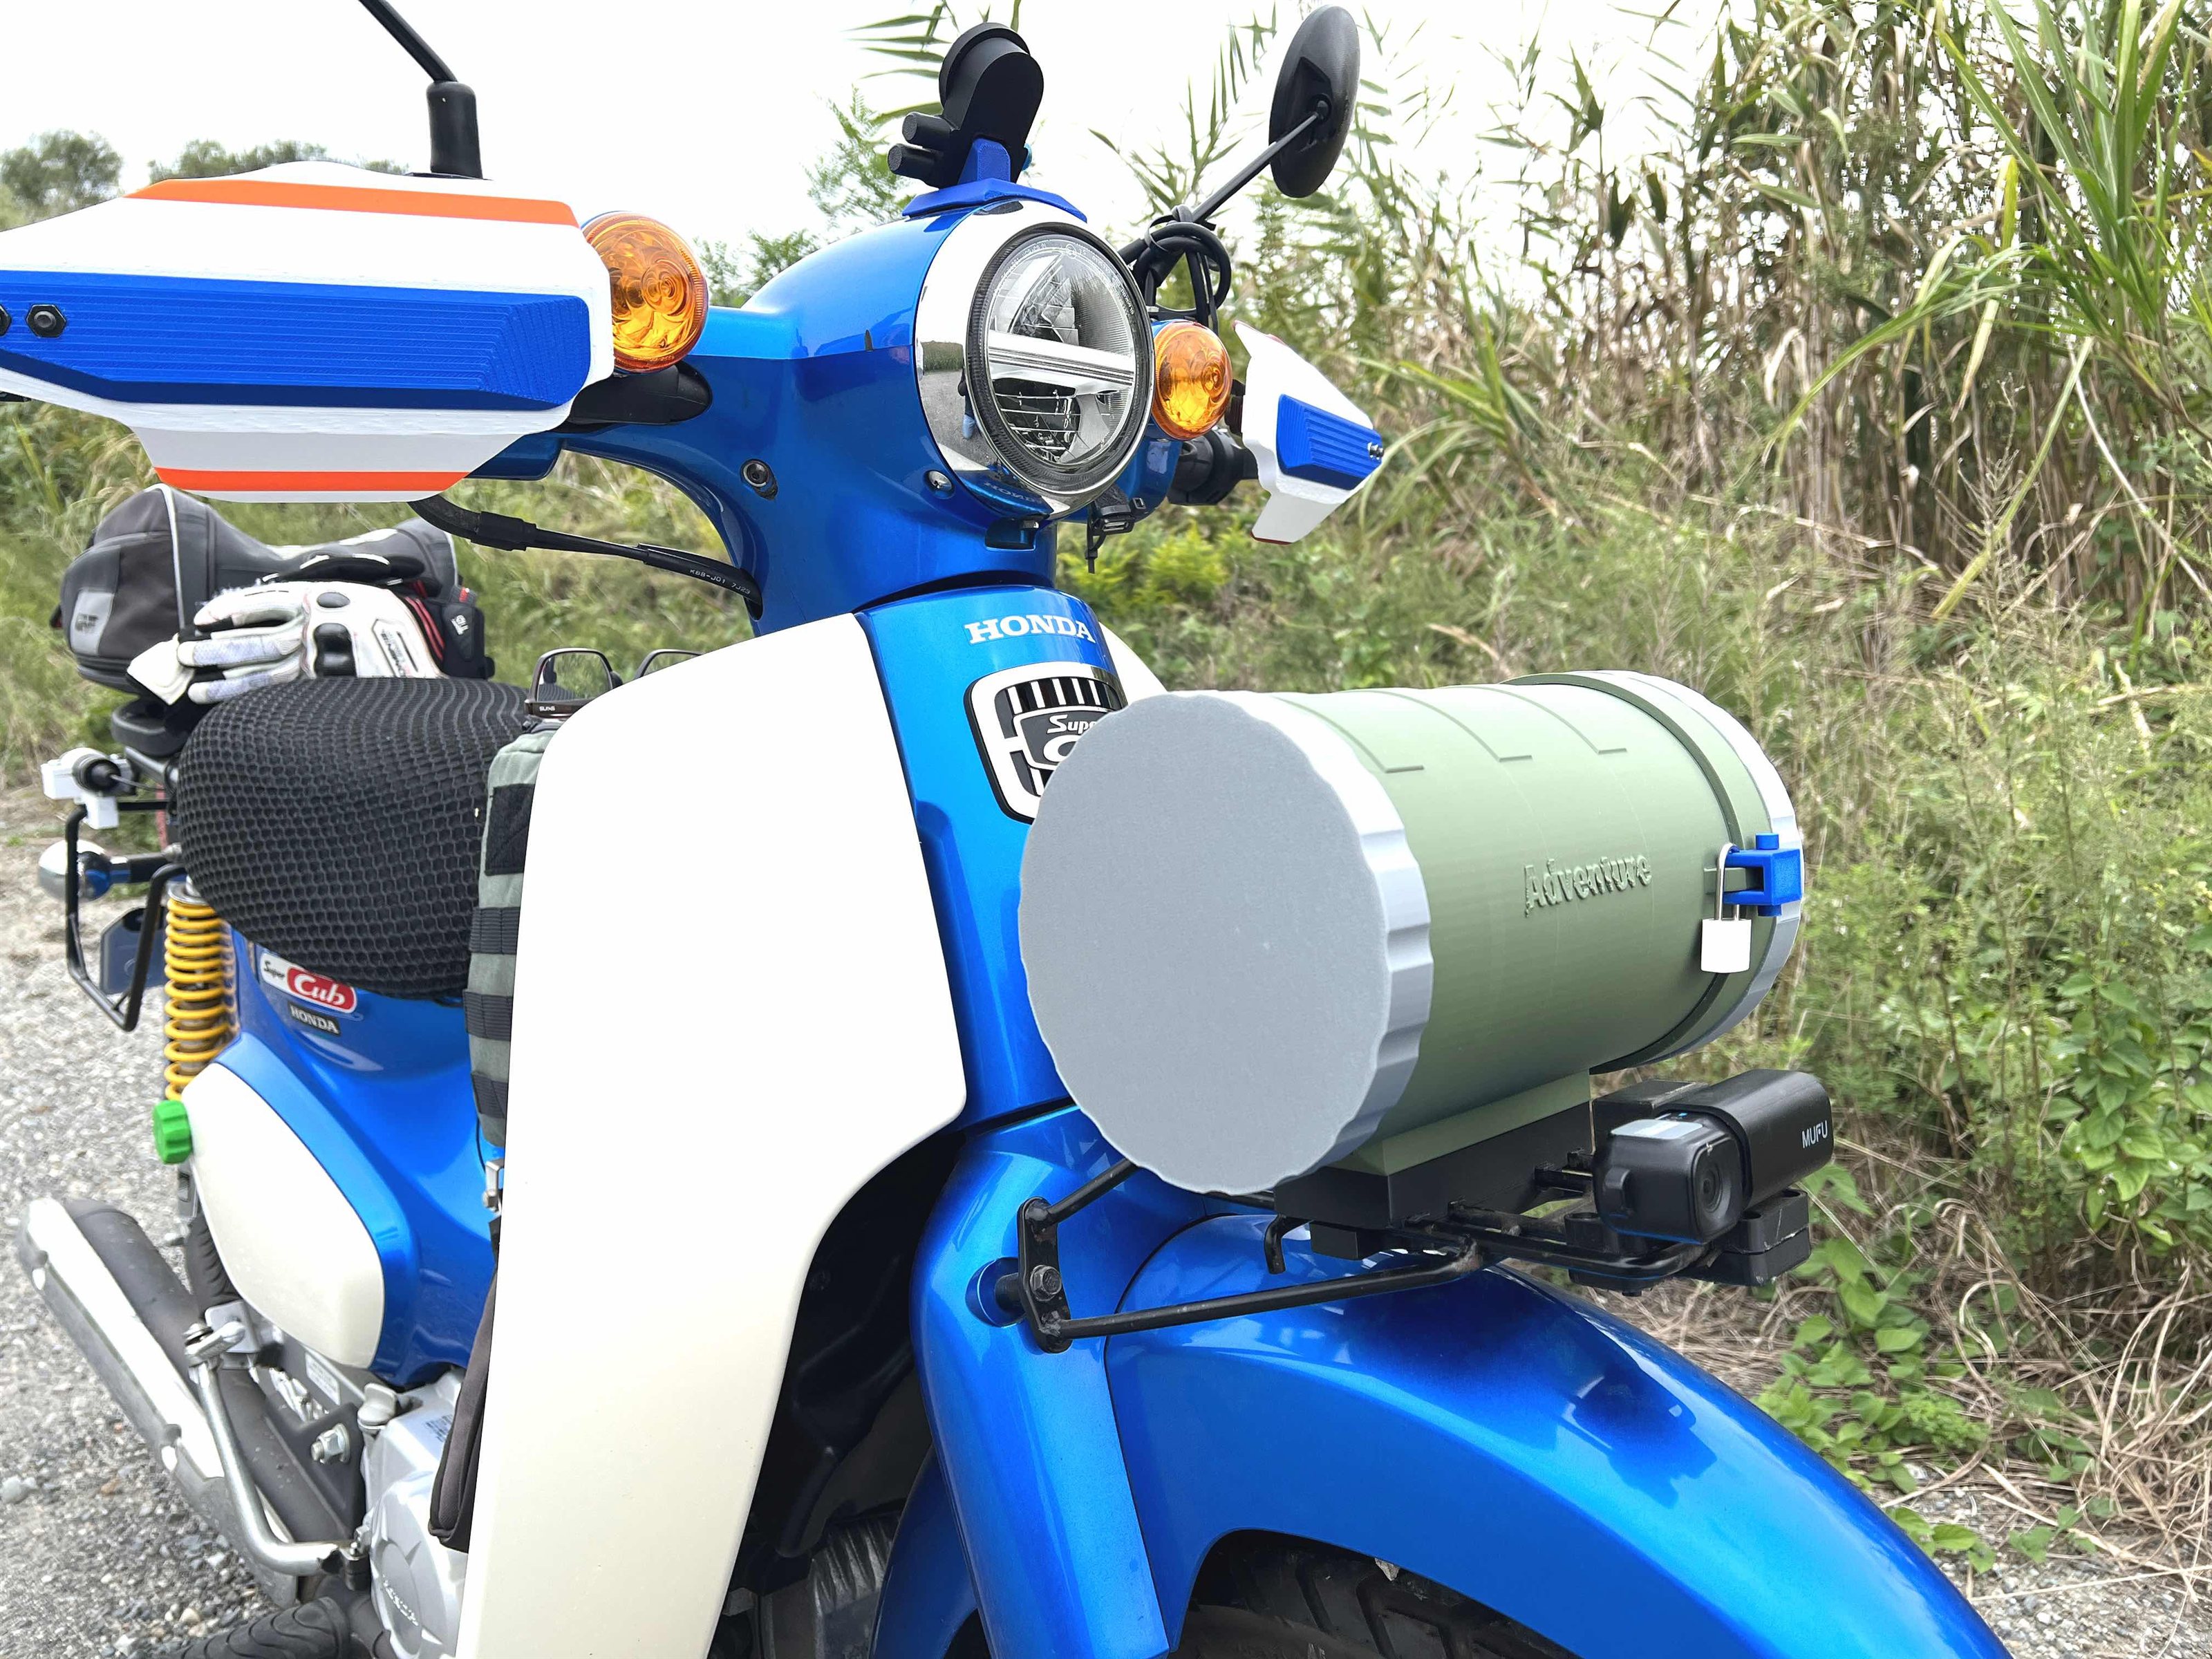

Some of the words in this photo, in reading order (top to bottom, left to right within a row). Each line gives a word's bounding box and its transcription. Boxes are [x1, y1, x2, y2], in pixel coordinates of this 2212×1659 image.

[965, 615, 1096, 644] HONDA
[1047, 714, 1097, 734] Supe
[1524, 854, 1653, 918] Adventure
[263, 959, 285, 980] Super
[294, 973, 346, 1005] Cub
[290, 1004, 339, 1034] HONDA
[1801, 1120, 1828, 1148] MUFU
